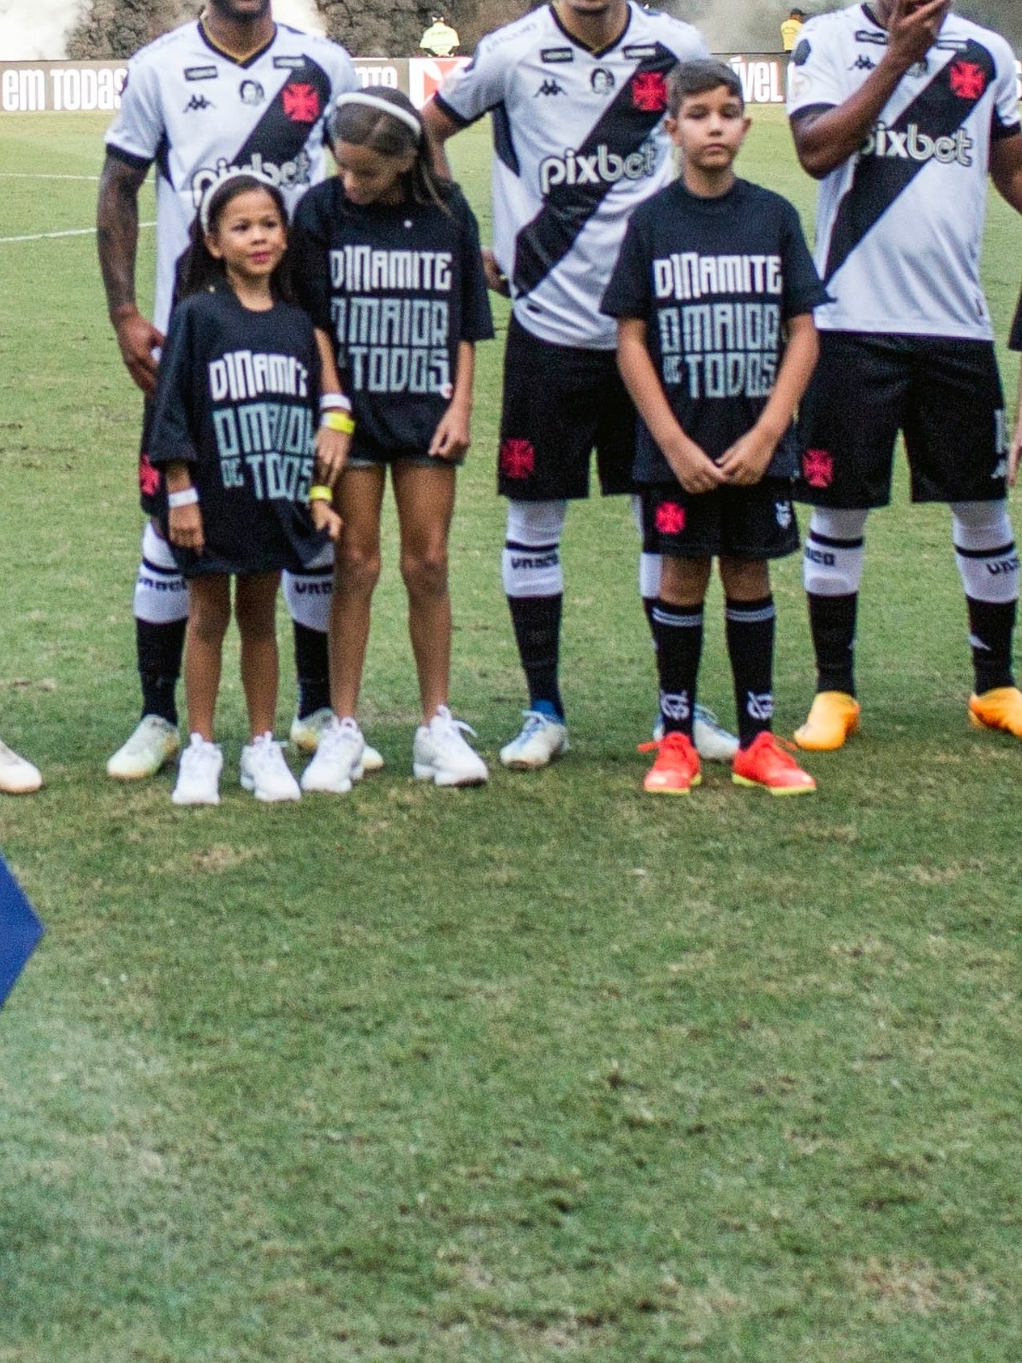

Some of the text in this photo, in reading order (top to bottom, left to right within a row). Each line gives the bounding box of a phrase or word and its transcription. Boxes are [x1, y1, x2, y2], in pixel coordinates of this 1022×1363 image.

[538, 137, 657, 195] pixbet
[330, 245, 452, 292] DINAMITE
[653, 252, 783, 301] DINAMITE
[349, 296, 450, 346] MAIOR
[658, 302, 780, 354] O MAIOR
[349, 346, 451, 394] TODOS
[685, 352, 778, 400] TODOS
[212, 407, 240, 457] O
